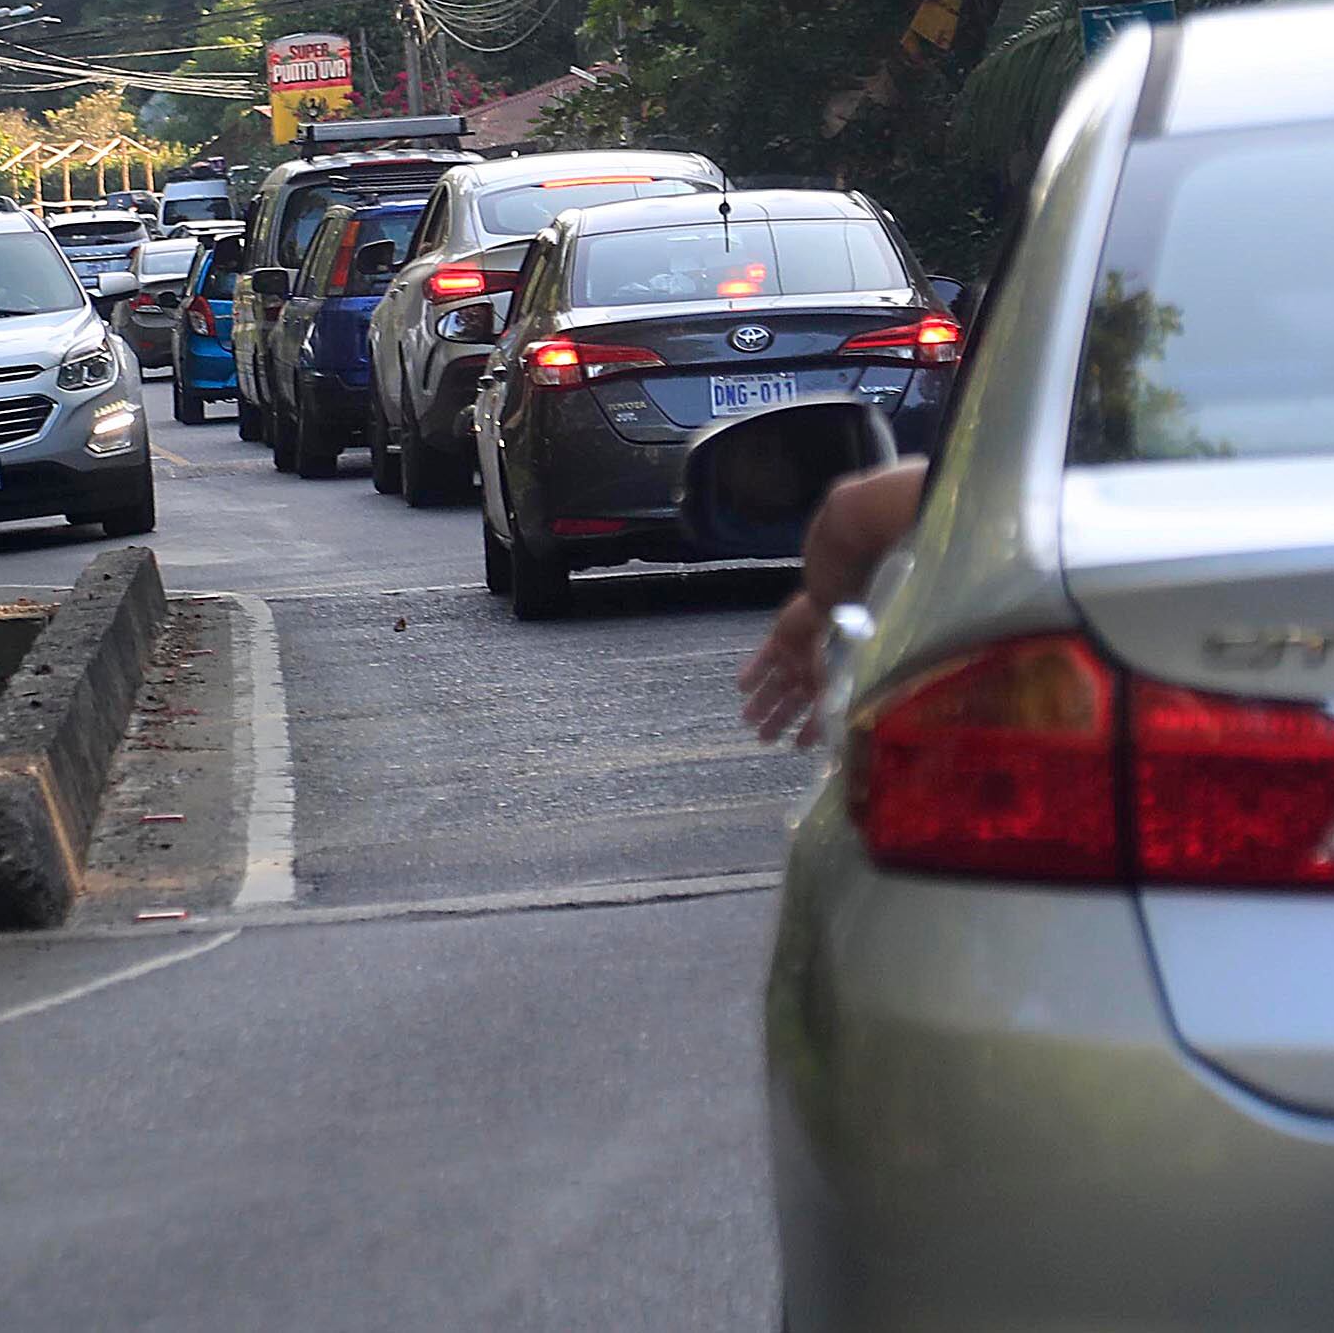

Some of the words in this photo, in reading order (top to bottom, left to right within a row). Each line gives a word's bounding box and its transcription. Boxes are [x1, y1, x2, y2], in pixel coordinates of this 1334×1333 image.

[288, 42, 329, 60] SUPER
[272, 61, 317, 84] PUNTA
[318, 58, 347, 80] UVA
